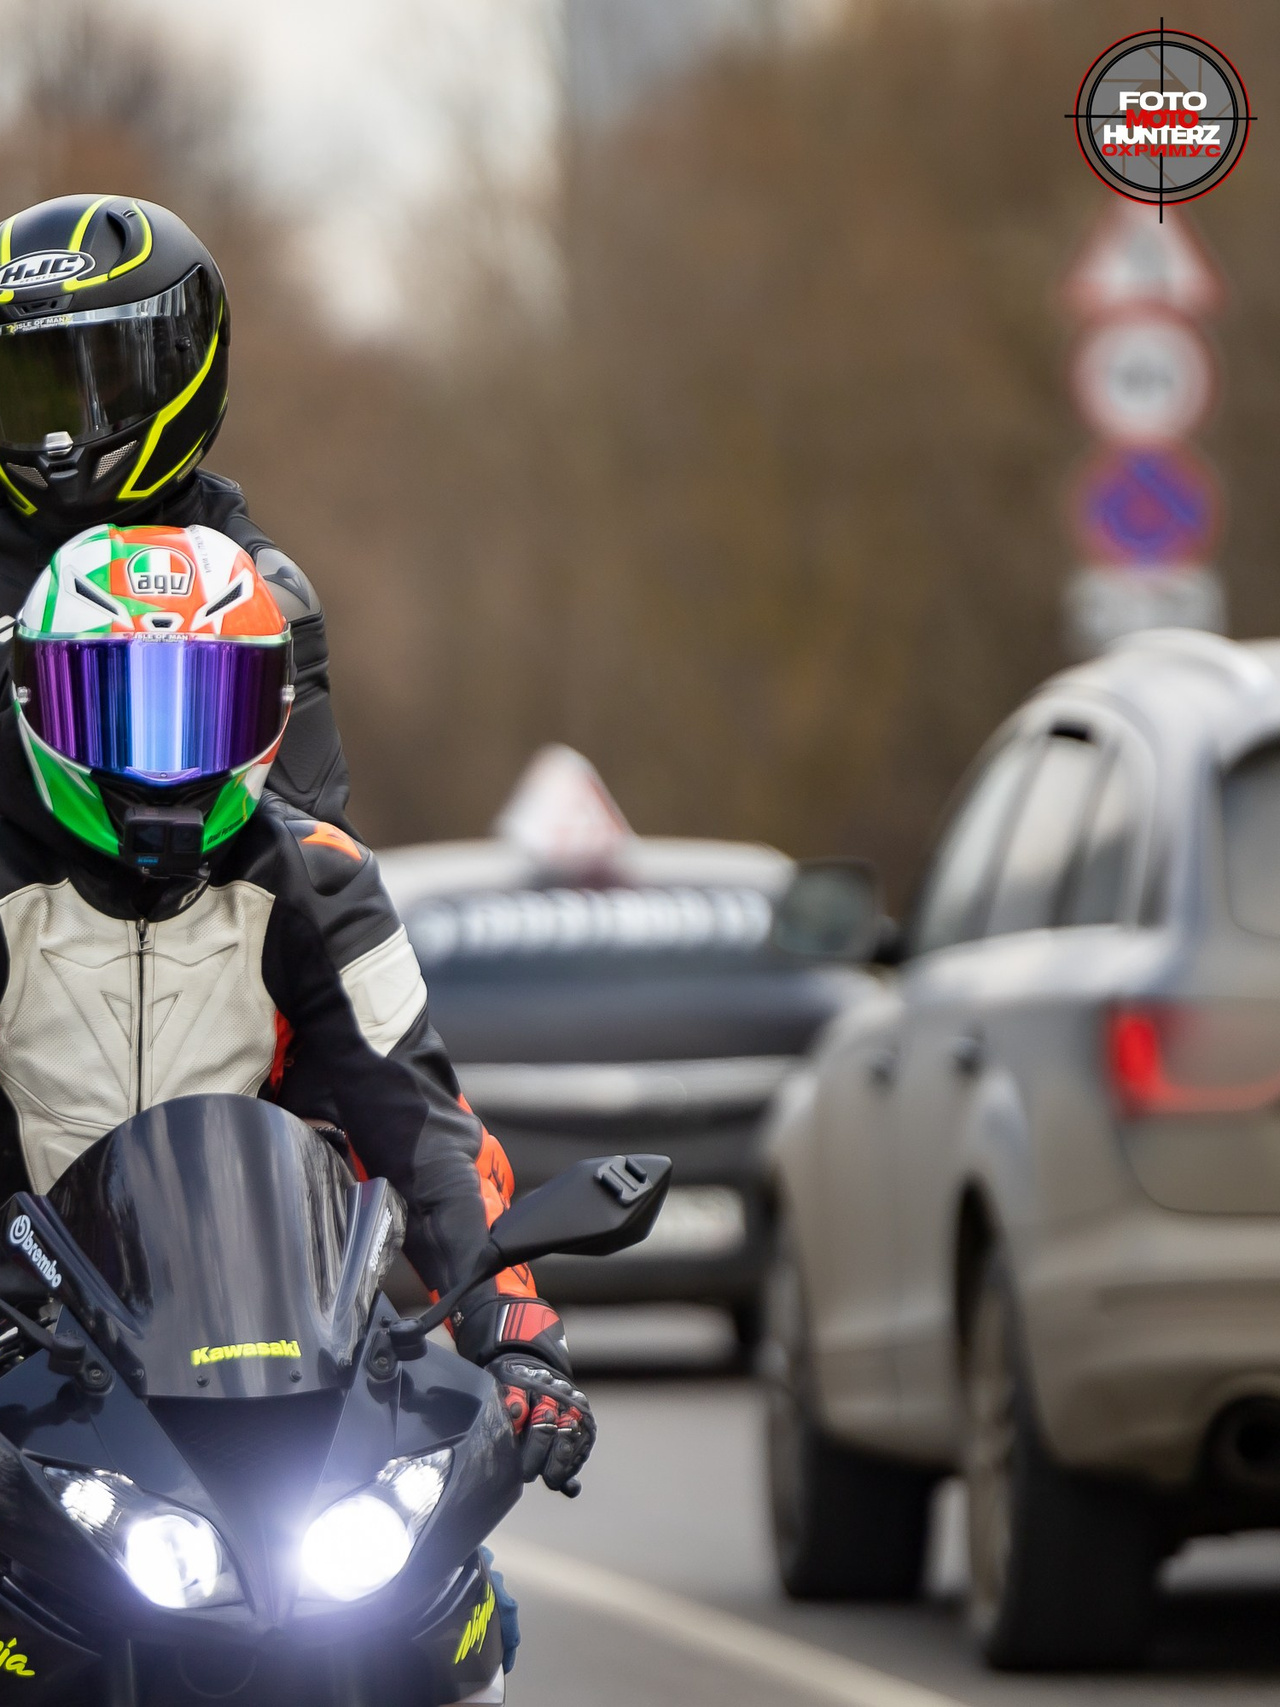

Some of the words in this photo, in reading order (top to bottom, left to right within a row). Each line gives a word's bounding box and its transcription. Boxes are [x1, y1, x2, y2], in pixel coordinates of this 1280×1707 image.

[0, 255, 80, 285] HJC
[14, 322, 32, 332] ISLE
[33, 319, 46, 328] OF
[46, 316, 65, 325] MAN
[137, 574, 185, 595] agv
[169, 633, 189, 641] MAN
[369, 1206, 393, 1272] SUPERBIKE
[22, 1229, 63, 1289] brembo
[190, 1338, 303, 1367] Kawasaki
[454, 1580, 496, 1665] Ninja
